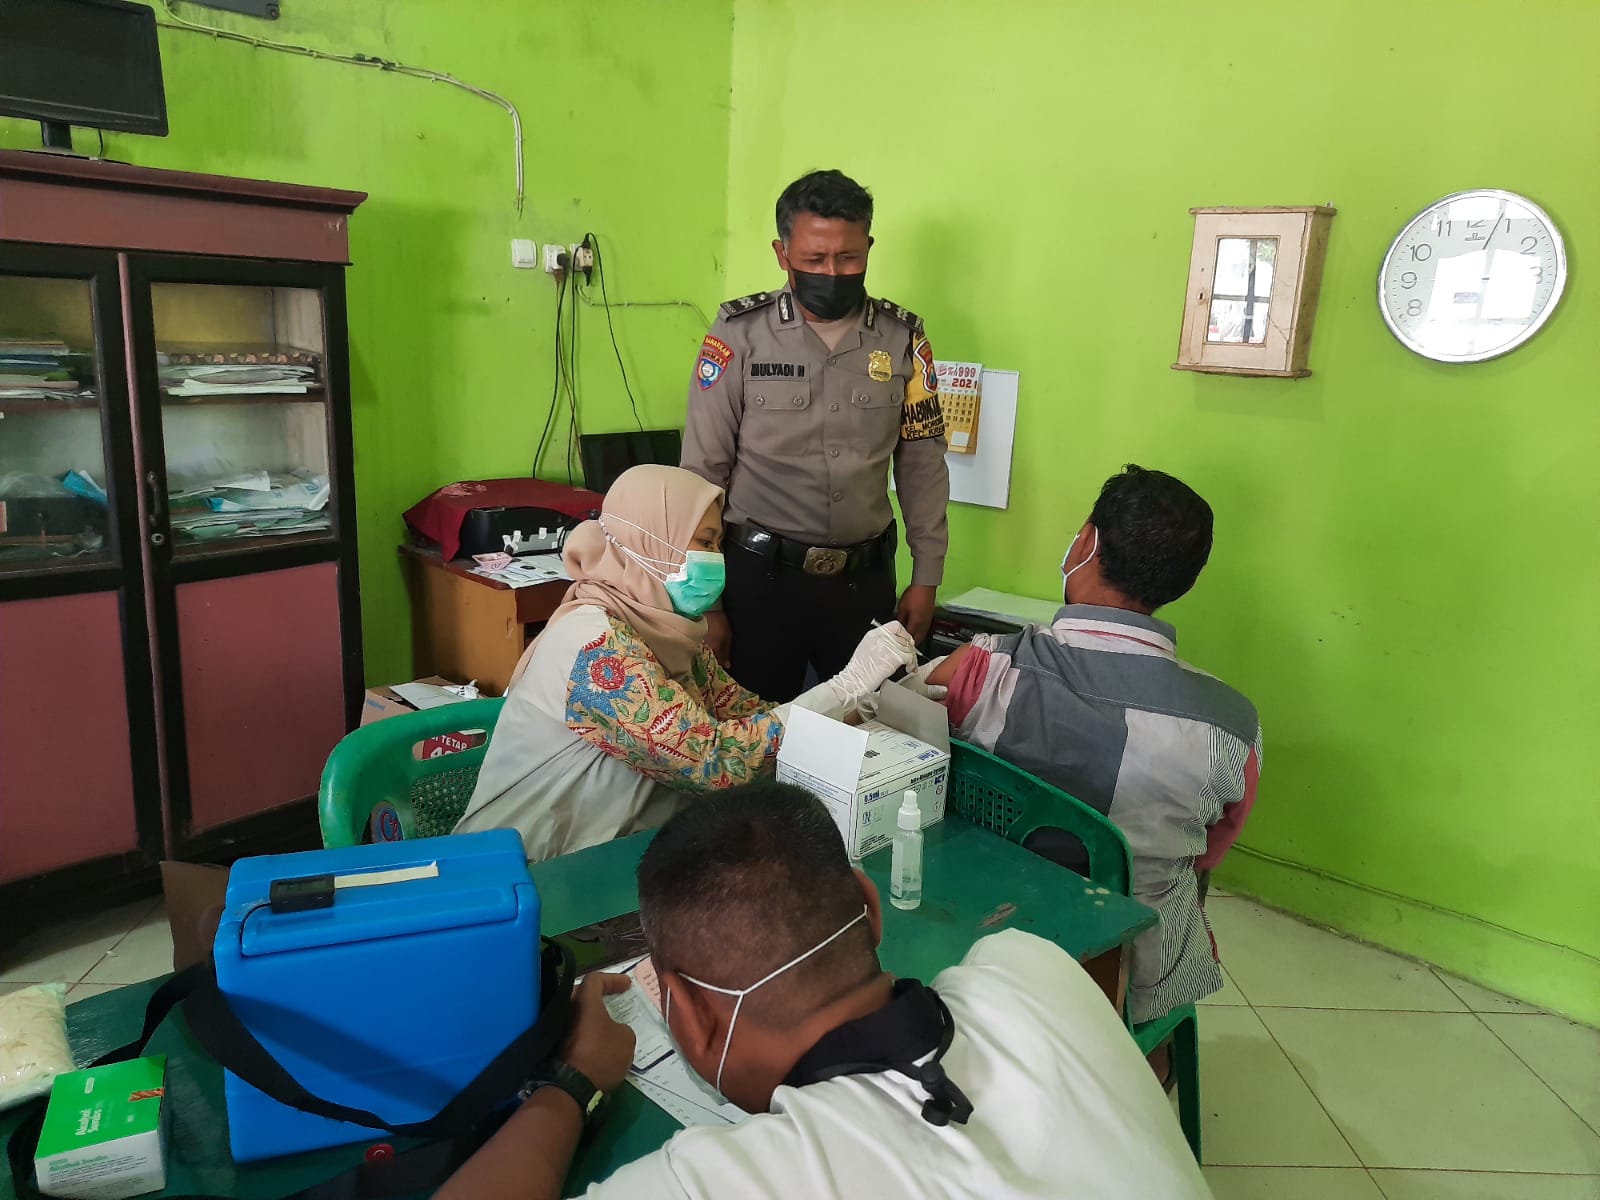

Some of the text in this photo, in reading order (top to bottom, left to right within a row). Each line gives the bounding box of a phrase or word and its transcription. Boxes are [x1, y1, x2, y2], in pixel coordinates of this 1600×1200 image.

[1437, 219, 1452, 237] 11
[1504, 218, 1512, 234] 1
[1409, 243, 1432, 262] 10
[1519, 236, 1538, 255] 2
[1400, 271, 1418, 290] 9
[1529, 266, 1544, 285] 3
[1406, 298, 1423, 317] 8
[750, 362, 795, 377] MULYADI
[951, 377, 977, 390] 2021
[441, 735, 468, 751] TETAP
